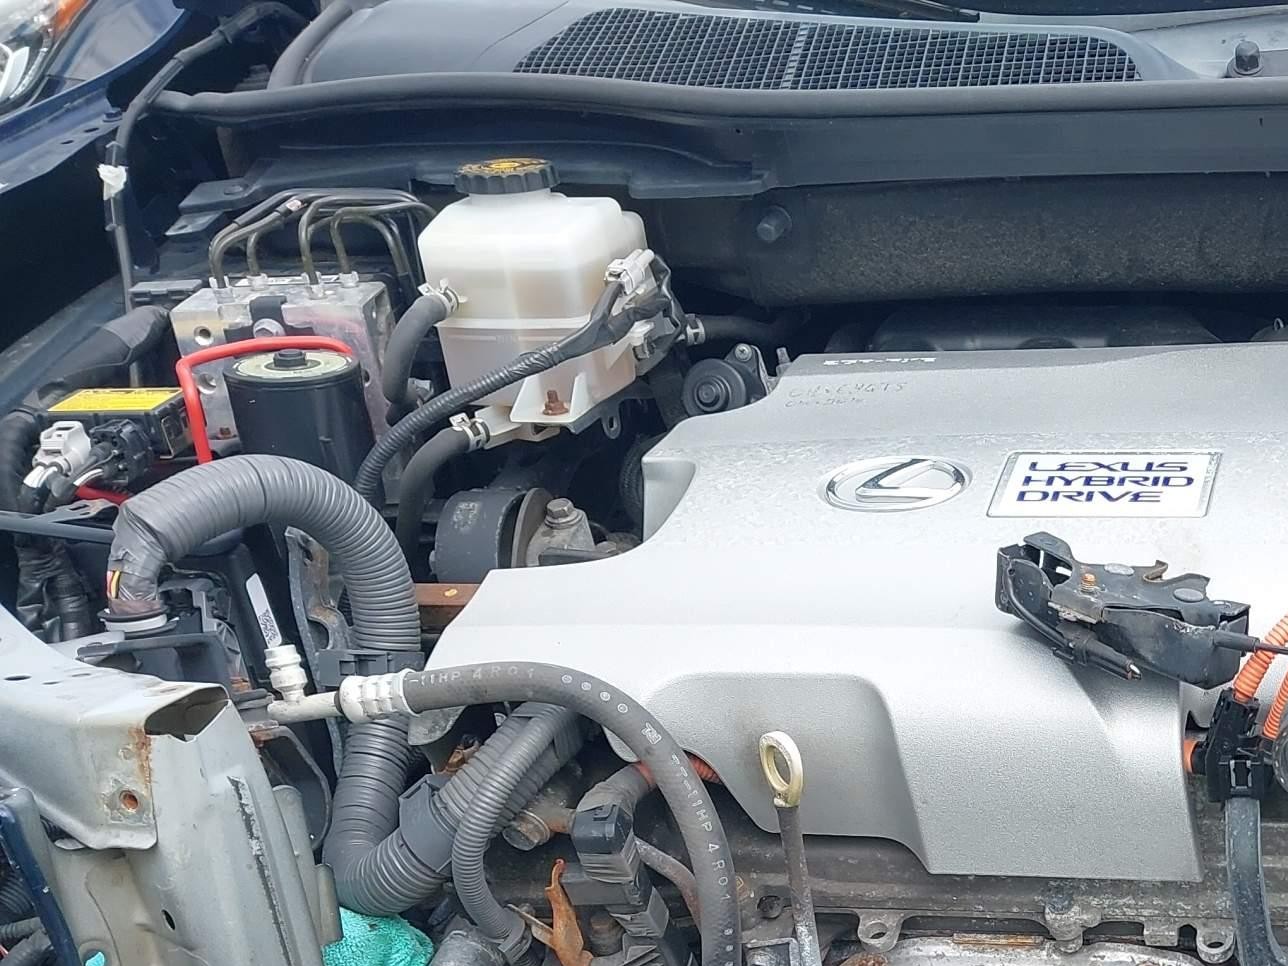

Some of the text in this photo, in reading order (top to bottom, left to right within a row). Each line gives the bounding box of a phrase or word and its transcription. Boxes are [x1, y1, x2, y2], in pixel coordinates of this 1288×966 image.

[1029, 461, 1188, 472] LEXUS
[1022, 475, 1194, 487] HYBRID
[1016, 490, 1164, 503] DRIVE
